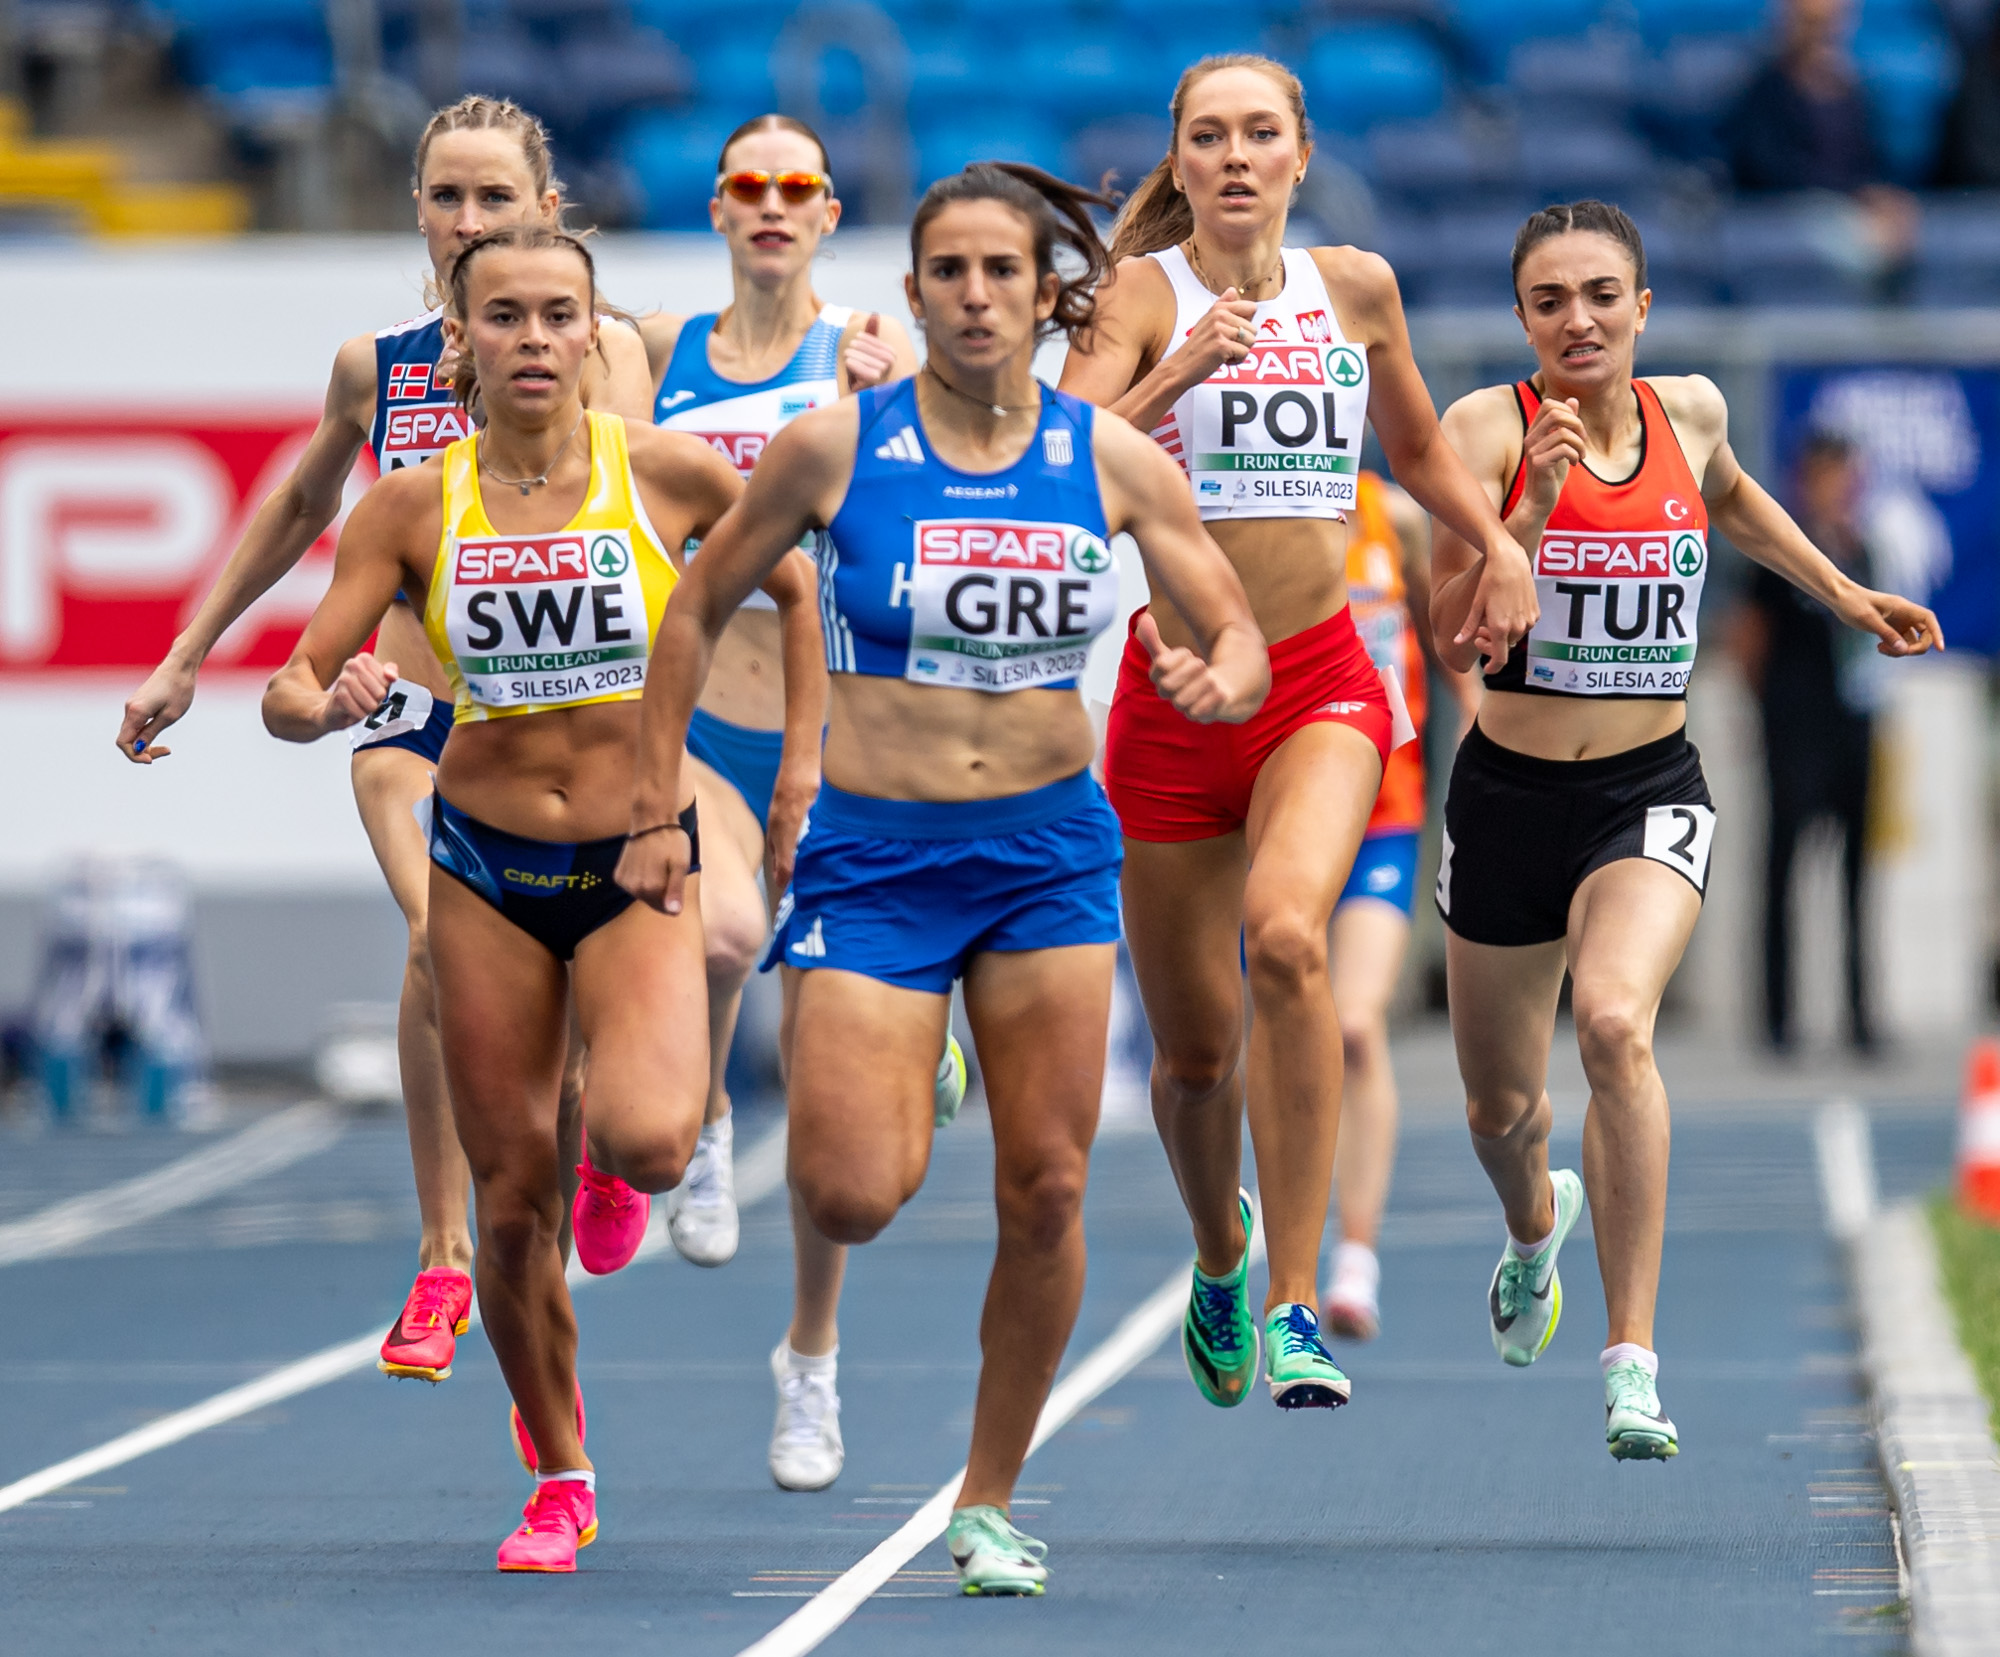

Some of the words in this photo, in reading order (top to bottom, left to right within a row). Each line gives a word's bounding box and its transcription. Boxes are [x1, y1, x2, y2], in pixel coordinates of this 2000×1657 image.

[388, 411, 476, 446] SPA
[1221, 390, 1349, 450] POL
[1234, 455, 1240, 469] I
[1243, 455, 1280, 470] RUN
[1254, 480, 1323, 498] SILESIA
[1326, 482, 1353, 500] 2023
[459, 541, 585, 580] SPAR
[924, 529, 1062, 566] SPAR
[1543, 540, 1667, 573] SPAR
[467, 583, 632, 651] SWE
[945, 573, 1091, 638] GRE
[1555, 581, 1688, 641] TUR
[487, 657, 494, 673] I
[498, 655, 537, 672] RUN
[972, 660, 1043, 686] SILESIA
[1045, 651, 1087, 675] 2023
[1568, 647, 1574, 660] I
[1577, 646, 1614, 662] RUN
[511, 676, 590, 699] SILESIA
[594, 665, 643, 689] 2023
[1586, 671, 1656, 689] SILESIA
[1668, 808, 1698, 866] 2
[503, 868, 580, 888] CRAFT
